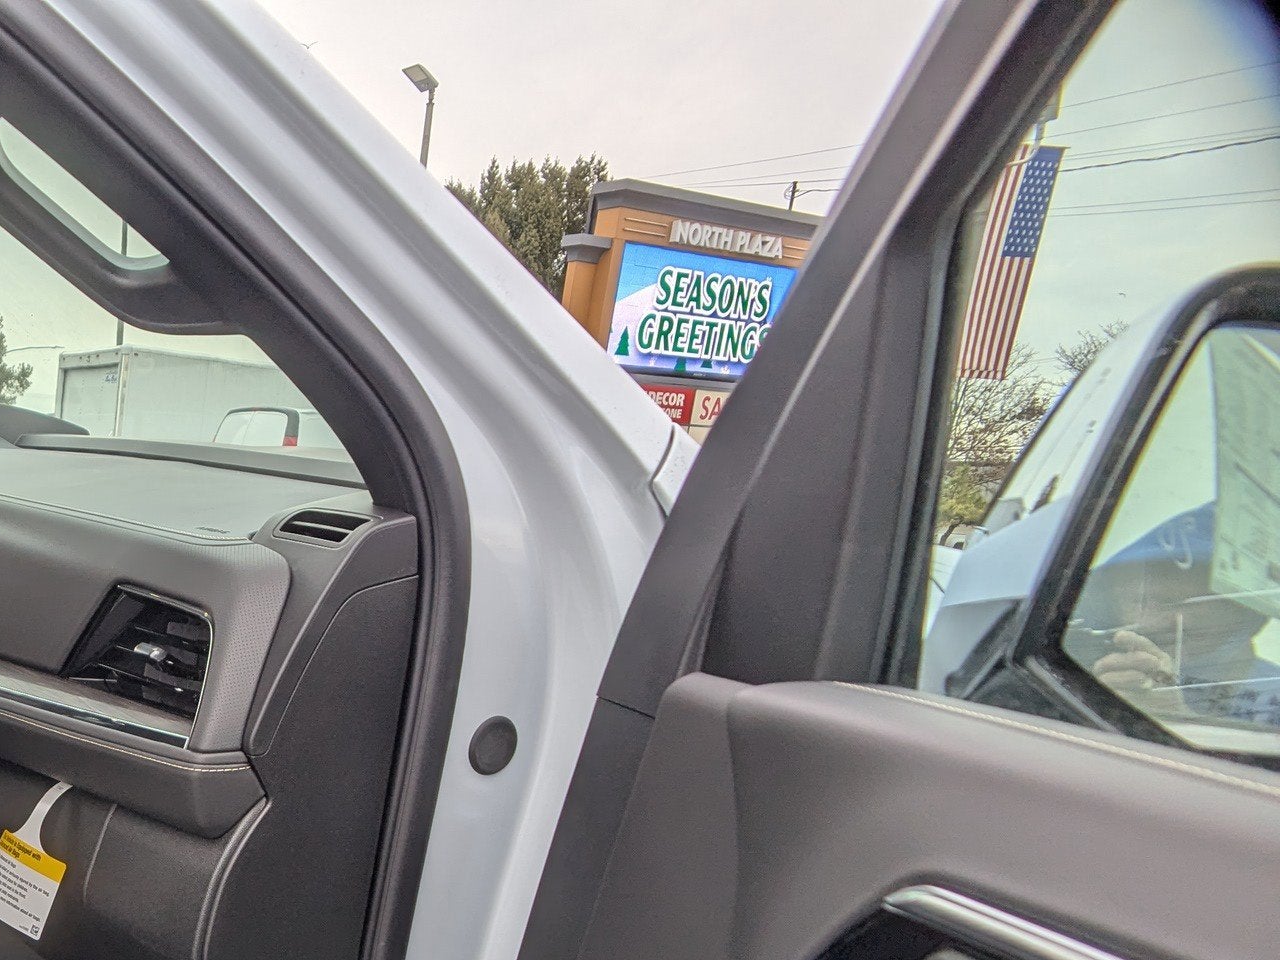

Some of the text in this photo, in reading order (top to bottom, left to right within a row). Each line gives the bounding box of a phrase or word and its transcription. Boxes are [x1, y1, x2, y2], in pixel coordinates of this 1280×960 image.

[670, 219, 783, 259] NORTH PLAZA
[655, 267, 772, 320] SEASON'S
